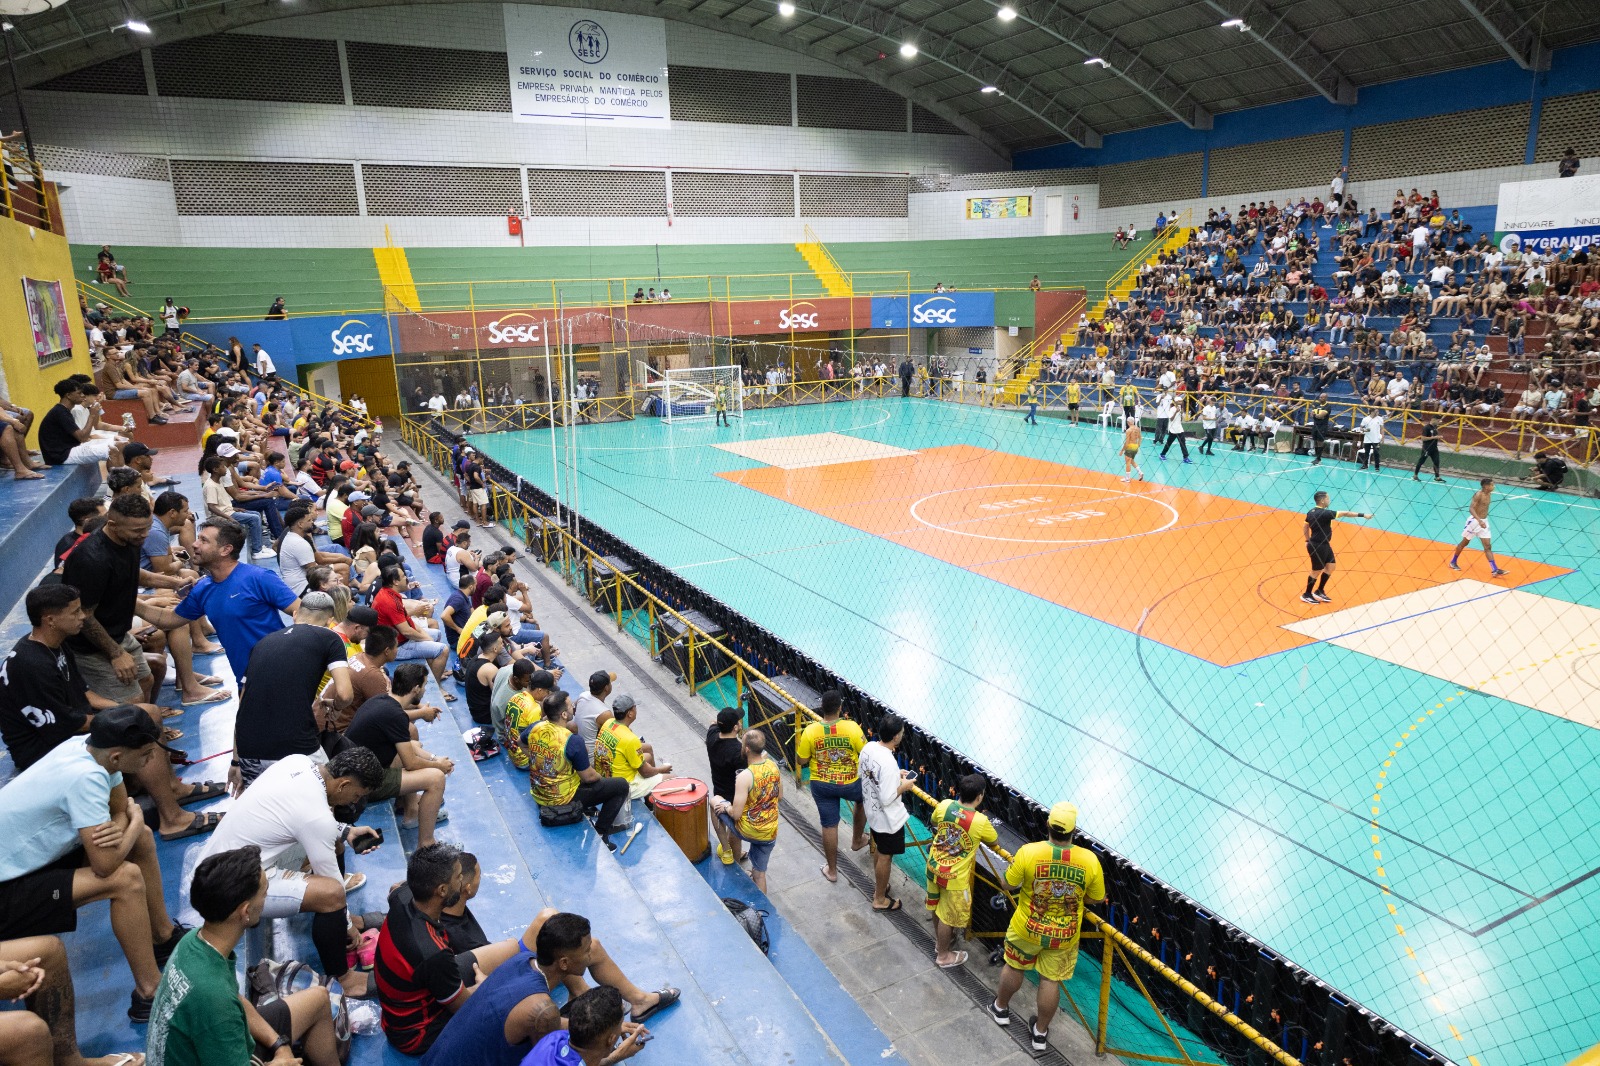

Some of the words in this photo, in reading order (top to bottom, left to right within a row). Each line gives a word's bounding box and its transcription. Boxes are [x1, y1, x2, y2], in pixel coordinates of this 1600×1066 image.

[578, 49, 601, 58] SESC
[519, 66, 557, 78] SERVIÇO
[563, 69, 594, 79] SOCIAL
[599, 72, 612, 80] DO
[617, 72, 659, 84] COMÉRCIO
[517, 81, 556, 92] EMPRESA
[560, 83, 594, 94] PRIVADA
[599, 86, 636, 96] MANTIDA
[640, 88, 663, 98] PELOS
[535, 93, 590, 105] EMPRESÁRIOS
[594, 97, 606, 106] DO
[610, 97, 648, 108] COMÉRCIO
[778, 309, 819, 329] Sesc
[912, 304, 957, 324] Sesc
[331, 329, 374, 355] Sesc
[488, 321, 540, 344] Sesc
